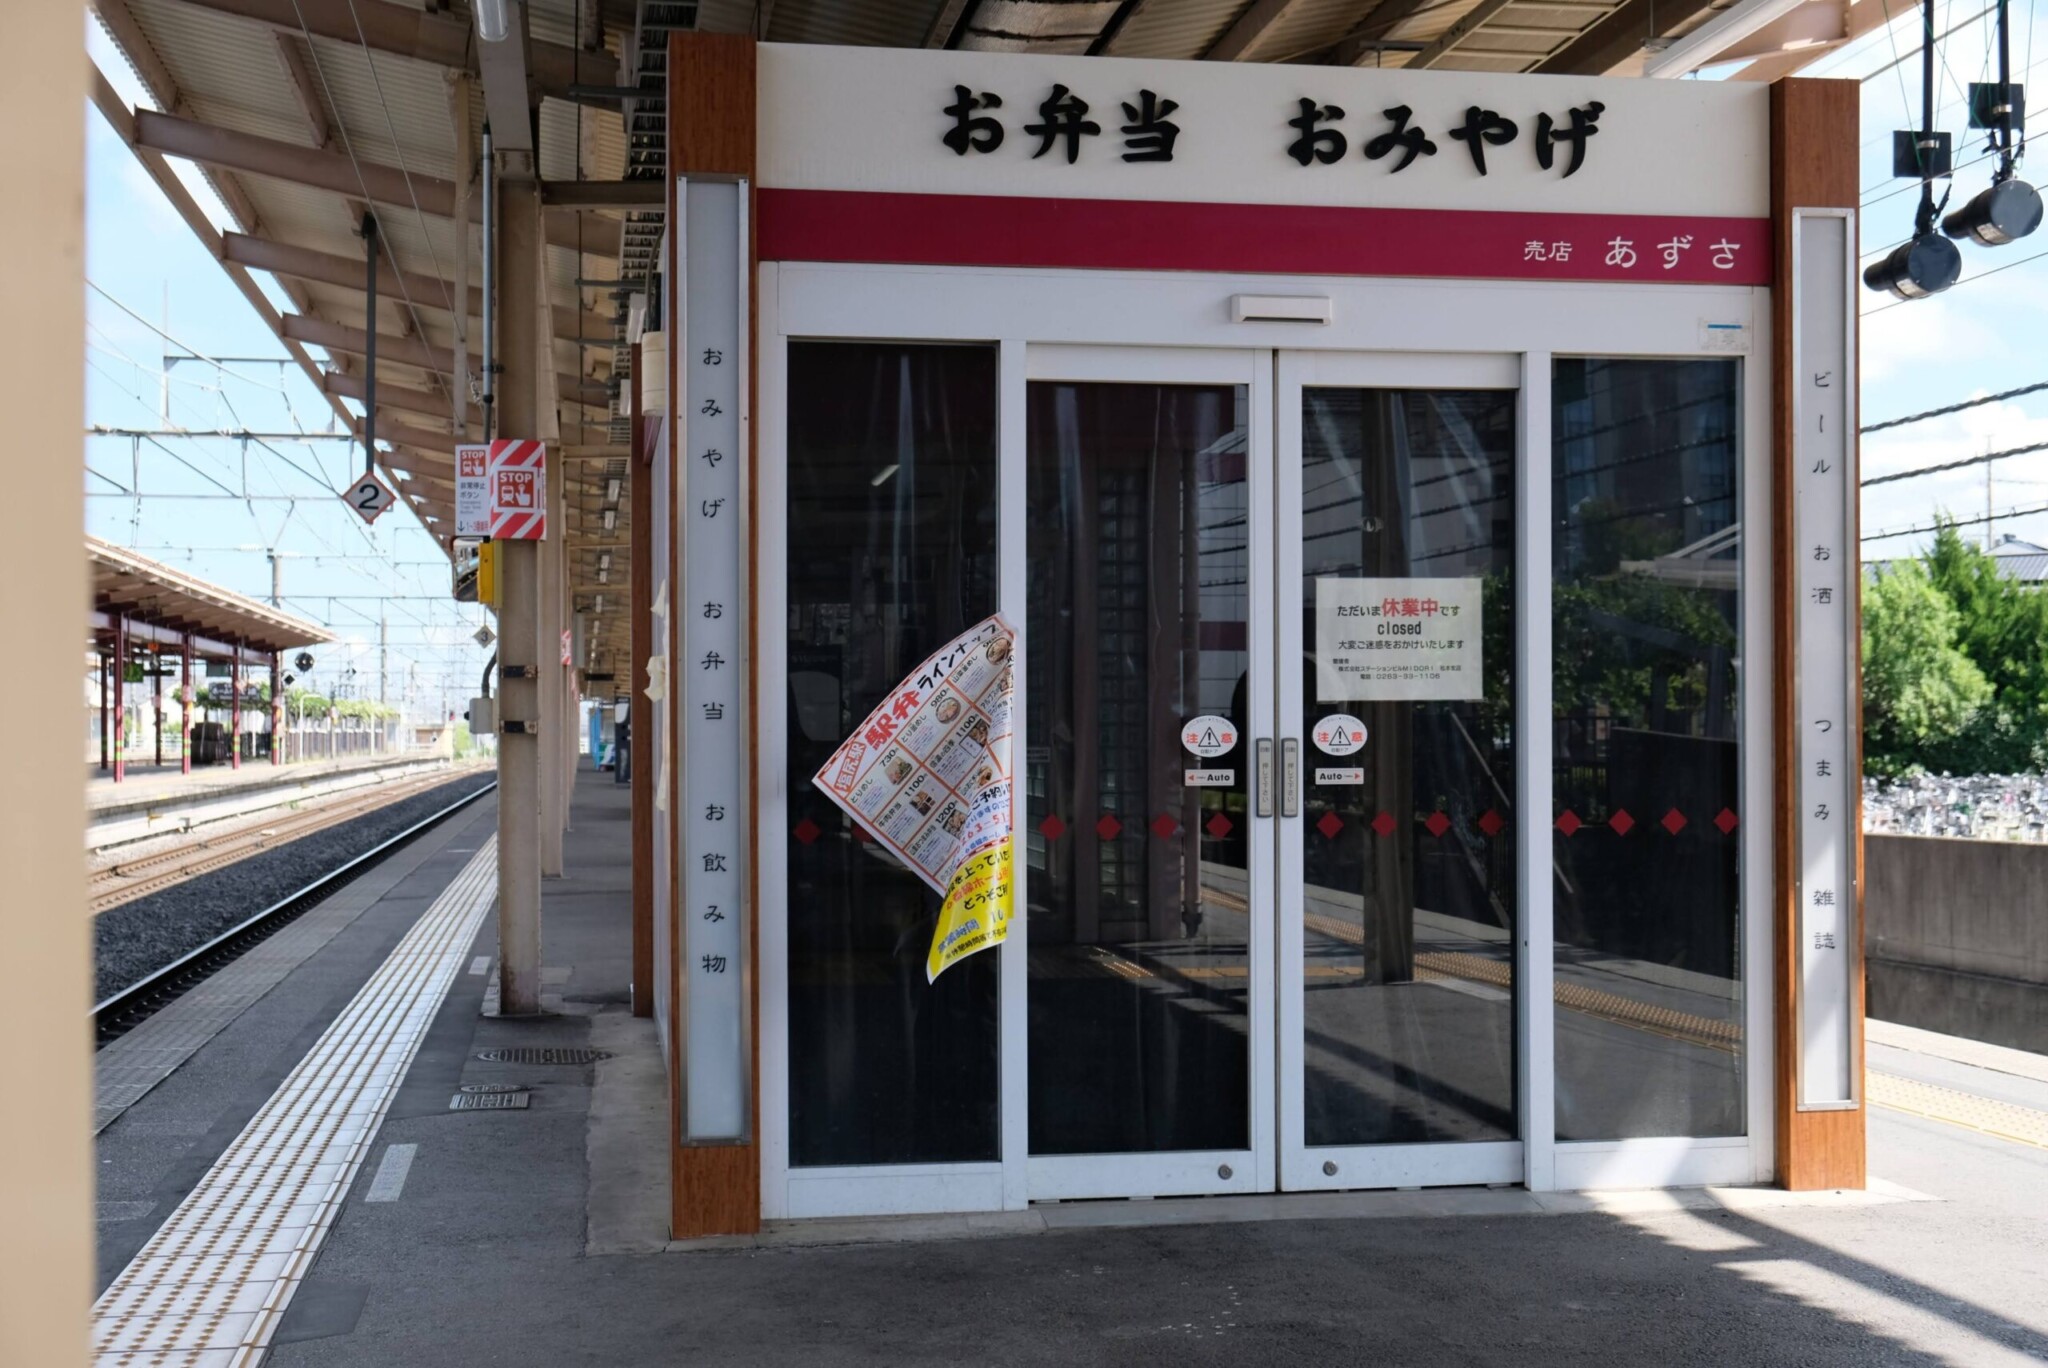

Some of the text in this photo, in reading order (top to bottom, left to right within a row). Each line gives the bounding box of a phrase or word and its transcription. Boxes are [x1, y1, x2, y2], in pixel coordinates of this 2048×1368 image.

[942, 82, 1606, 179] お弁当 おみやげ
[1523, 234, 1742, 270] 売店 あずさ
[701, 347, 725, 519] おみやげ
[1812, 371, 1832, 475] ビール
[461, 451, 485, 460] STOP
[499, 472, 532, 483] STOP
[357, 483, 380, 510] 2
[1811, 544, 1833, 605] お酒
[1336, 597, 1461, 618] ただいま休業中です
[481, 631, 489, 642] 3
[1377, 621, 1422, 635] closed
[1338, 639, 1465, 650] 大変ご迷惑をおかけいたします
[701, 600, 726, 721] お弁当
[1207, 773, 1231, 782] Auto
[1319, 772, 1343, 780] Auto
[1813, 718, 1832, 821] つまみ
[701, 803, 728, 974] お飲み物
[1813, 888, 1836, 951] 雑誌
